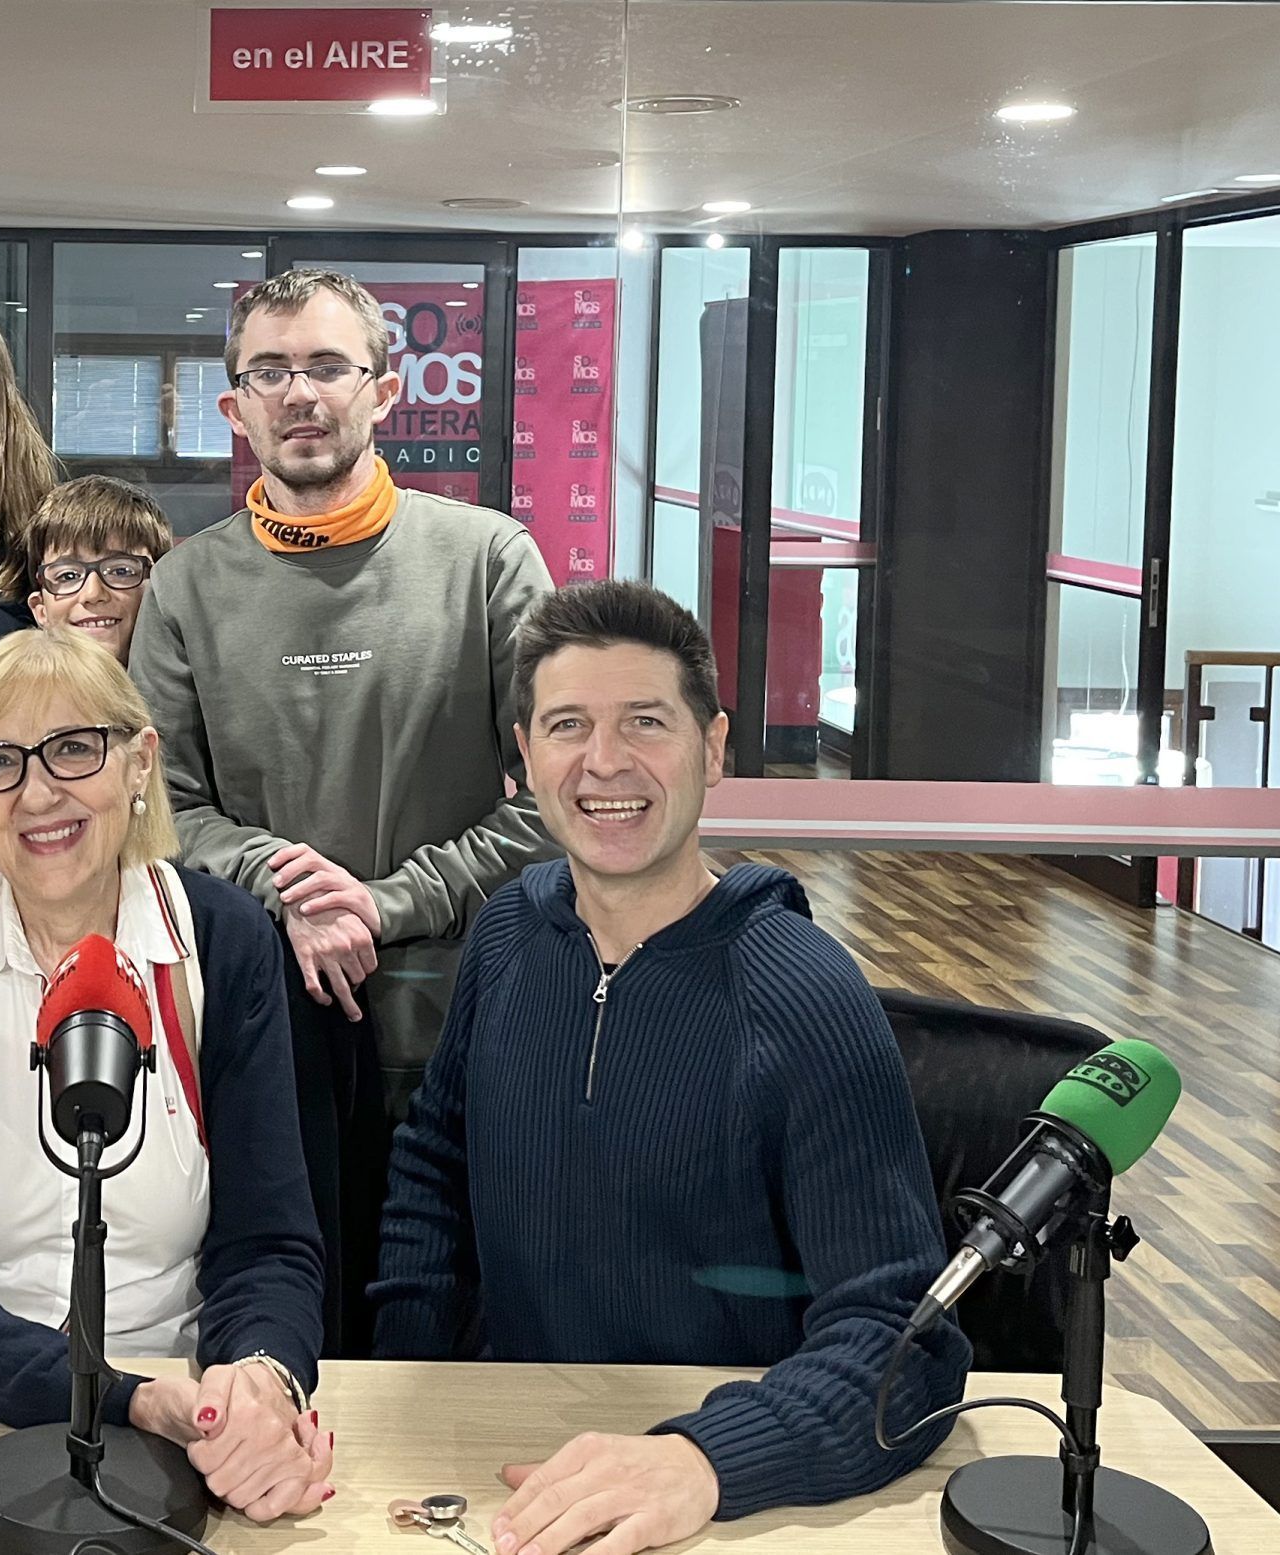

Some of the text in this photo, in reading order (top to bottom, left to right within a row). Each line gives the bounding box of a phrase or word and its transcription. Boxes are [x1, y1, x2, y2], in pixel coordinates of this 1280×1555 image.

[232, 40, 409, 69] en el AIRE
[573, 366, 599, 379] MOS
[572, 431, 598, 444] MOS
[570, 495, 596, 508] MOS
[568, 558, 595, 572] MOS
[281, 650, 373, 665] CURATED STAPLES
[1073, 1066, 1124, 1091] ERO
